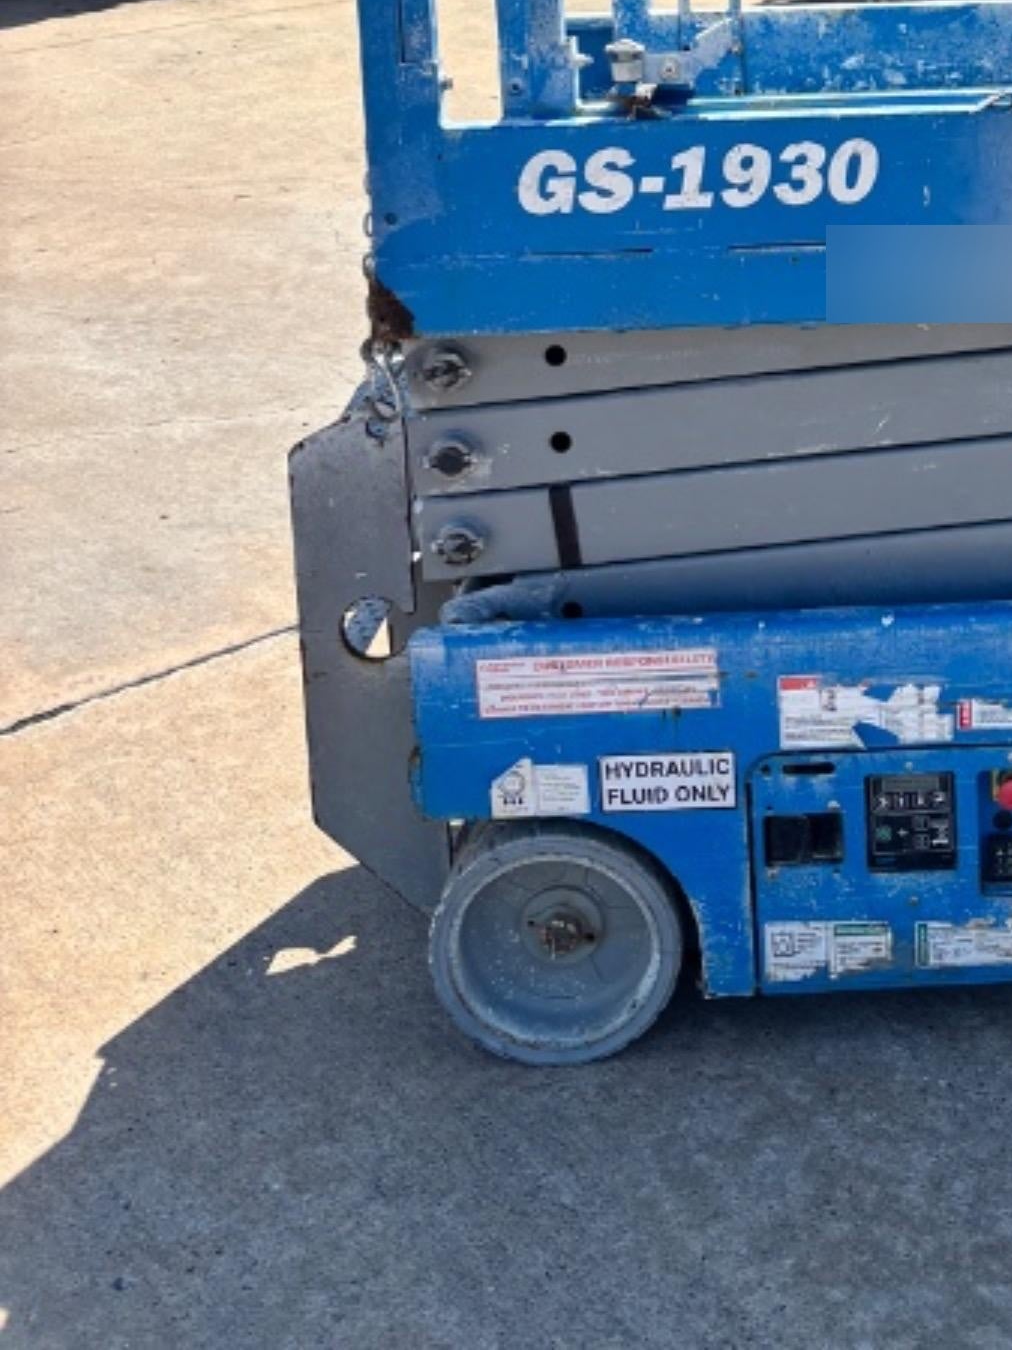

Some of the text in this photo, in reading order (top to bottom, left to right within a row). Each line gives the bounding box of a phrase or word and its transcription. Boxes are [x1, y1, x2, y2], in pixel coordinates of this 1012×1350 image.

[517, 137, 880, 217] GS-1930
[604, 758, 730, 780] HYDRAULIC
[607, 783, 730, 806] FLUID ONLY
